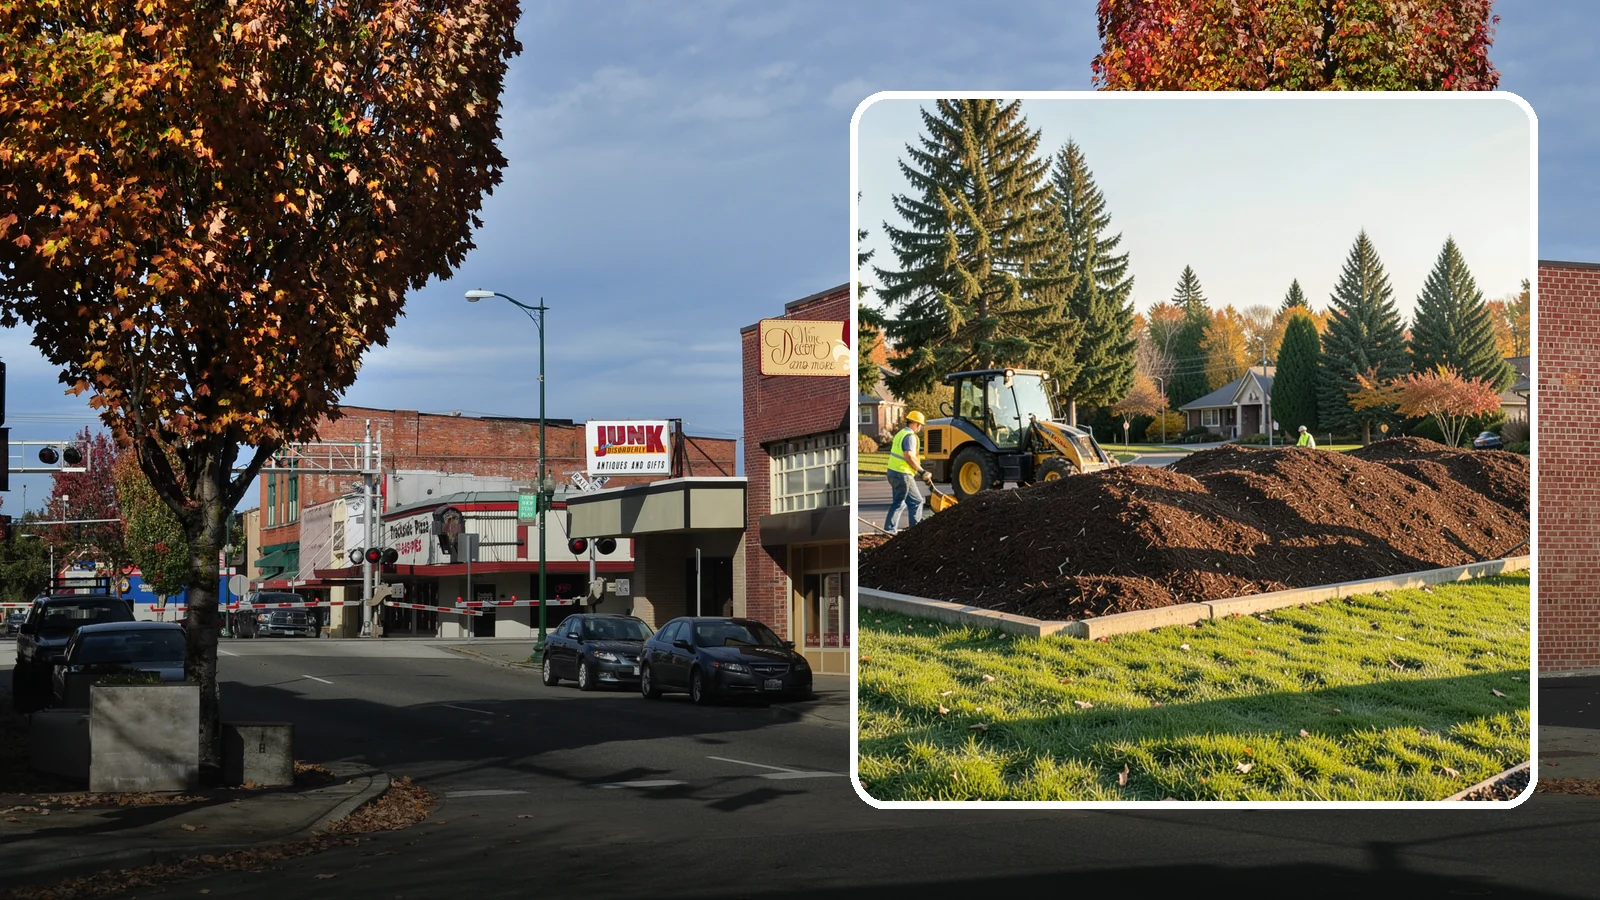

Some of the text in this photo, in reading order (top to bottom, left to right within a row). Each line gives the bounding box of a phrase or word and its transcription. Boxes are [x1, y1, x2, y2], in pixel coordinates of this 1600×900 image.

[764, 327, 831, 365] Decor
[595, 425, 665, 457] JUNK
[607, 446, 646, 454] DISORDERLY
[596, 460, 665, 470] ANTIQUES AND GIFTS
[390, 519, 429, 540] Trackside Pizza
